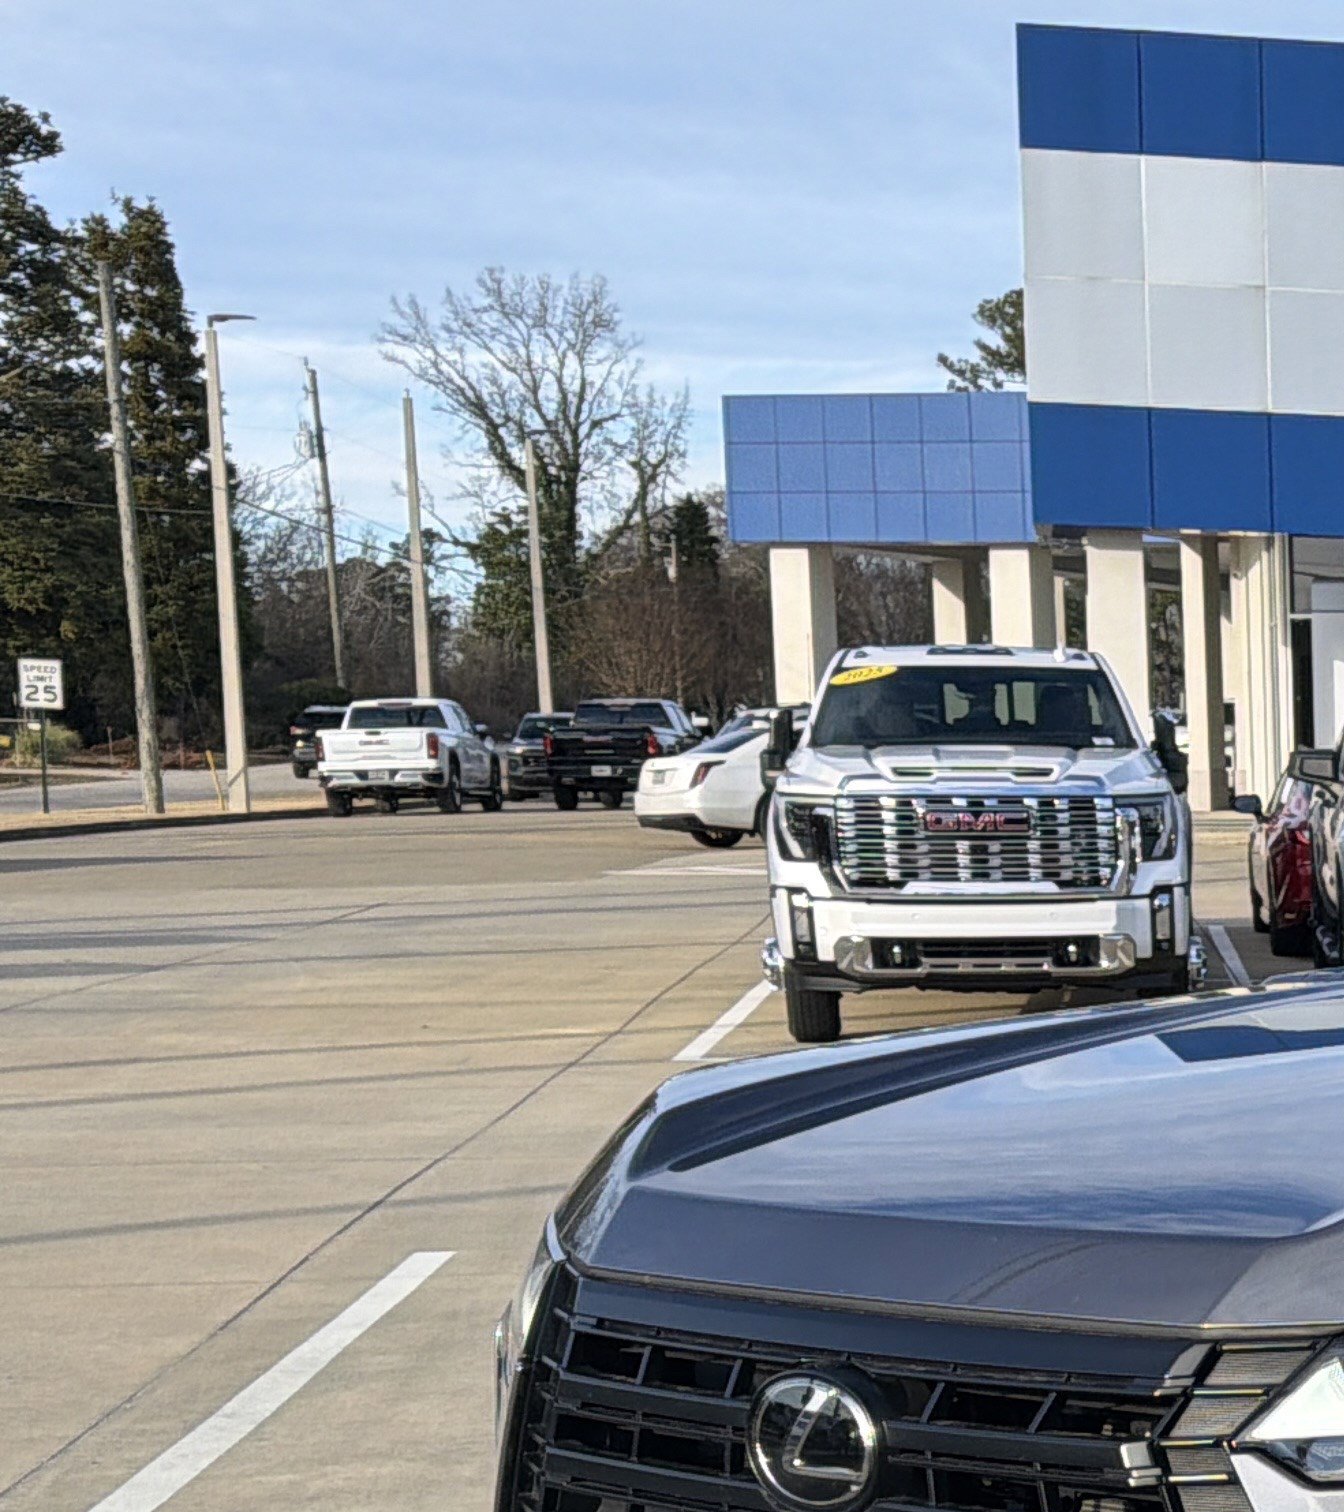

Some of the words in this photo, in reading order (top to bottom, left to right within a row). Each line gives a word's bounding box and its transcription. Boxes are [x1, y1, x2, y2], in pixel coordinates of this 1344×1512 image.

[23, 664, 57, 674] SPEED
[26, 675, 53, 683] LIMIT
[25, 684, 58, 703] 25
[925, 812, 1029, 831] GMC
